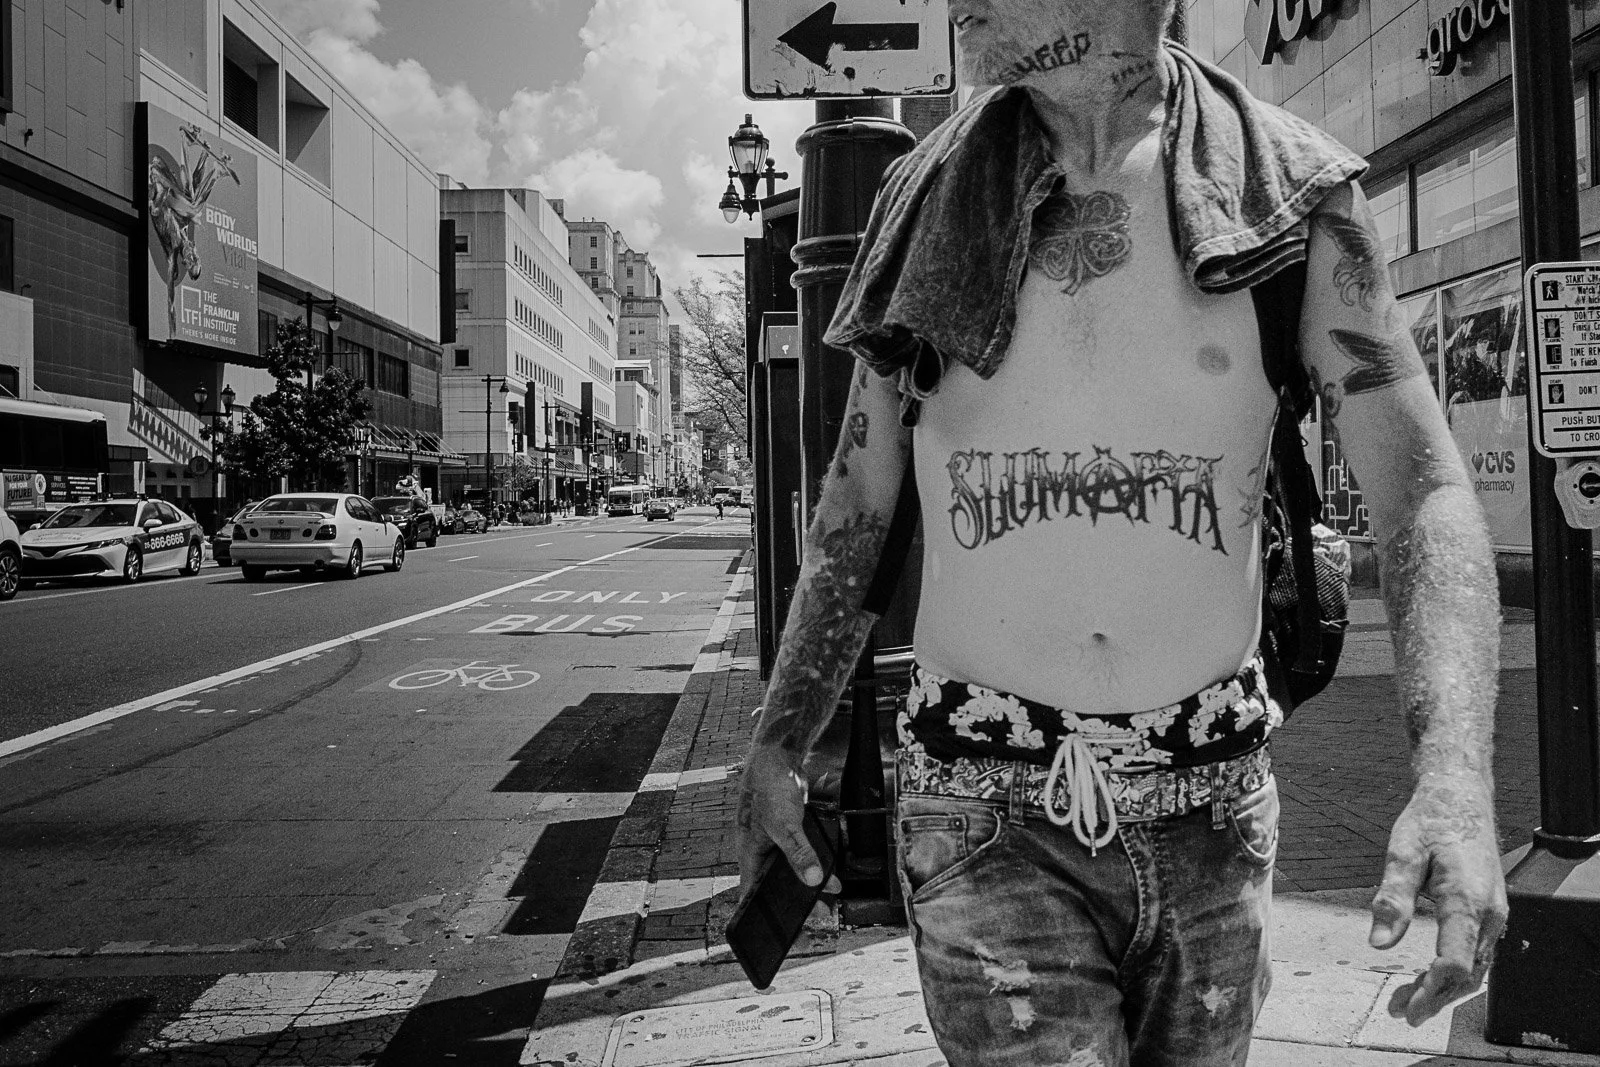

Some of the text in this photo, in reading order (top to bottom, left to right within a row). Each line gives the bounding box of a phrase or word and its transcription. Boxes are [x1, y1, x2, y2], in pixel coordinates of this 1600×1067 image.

[206, 207, 236, 231] BODY
[216, 227, 257, 255] WORLDS
[1565, 274, 1584, 284] START
[203, 290, 218, 304] THE
[203, 303, 240, 322] FRANKLIN
[203, 317, 237, 334] INSTITUTE
[204, 332, 219, 342] MORE
[220, 335, 237, 345] INSIDE
[1570, 347, 1585, 356] TIME
[1570, 358, 1577, 367] To
[1580, 357, 1597, 366] Finish
[1562, 416, 1583, 425] PUSH
[1570, 432, 1600, 442] TO CRO
[1485, 450, 1515, 474] CVS
[1475, 478, 1515, 494] pharmacy
[531, 590, 688, 604] ONLY
[468, 614, 643, 633] BUS
